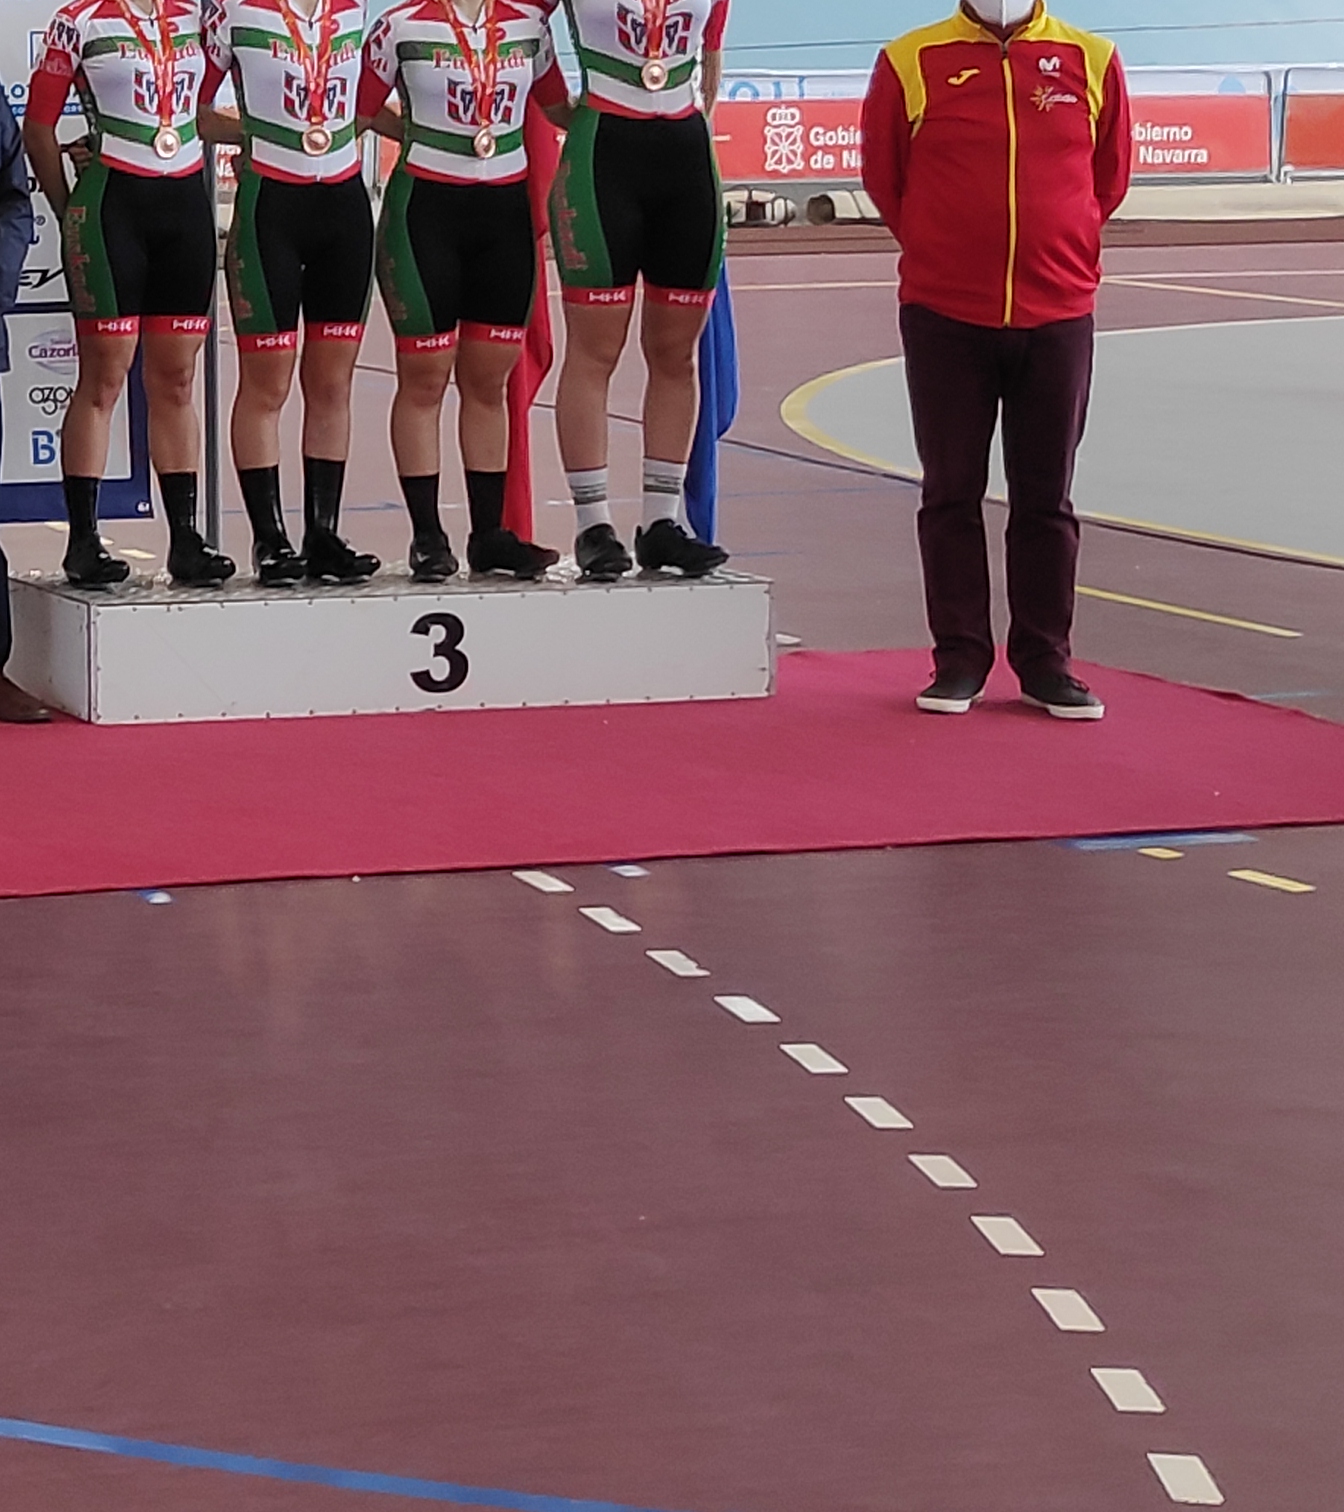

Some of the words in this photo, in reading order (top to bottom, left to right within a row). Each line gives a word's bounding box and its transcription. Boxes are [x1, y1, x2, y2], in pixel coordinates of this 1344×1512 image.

[1134, 121, 1192, 142] bierno
[810, 150, 835, 169] de
[1139, 145, 1208, 164] Navarra
[29, 345, 79, 358] Cazorl
[409, 612, 469, 693] 3
